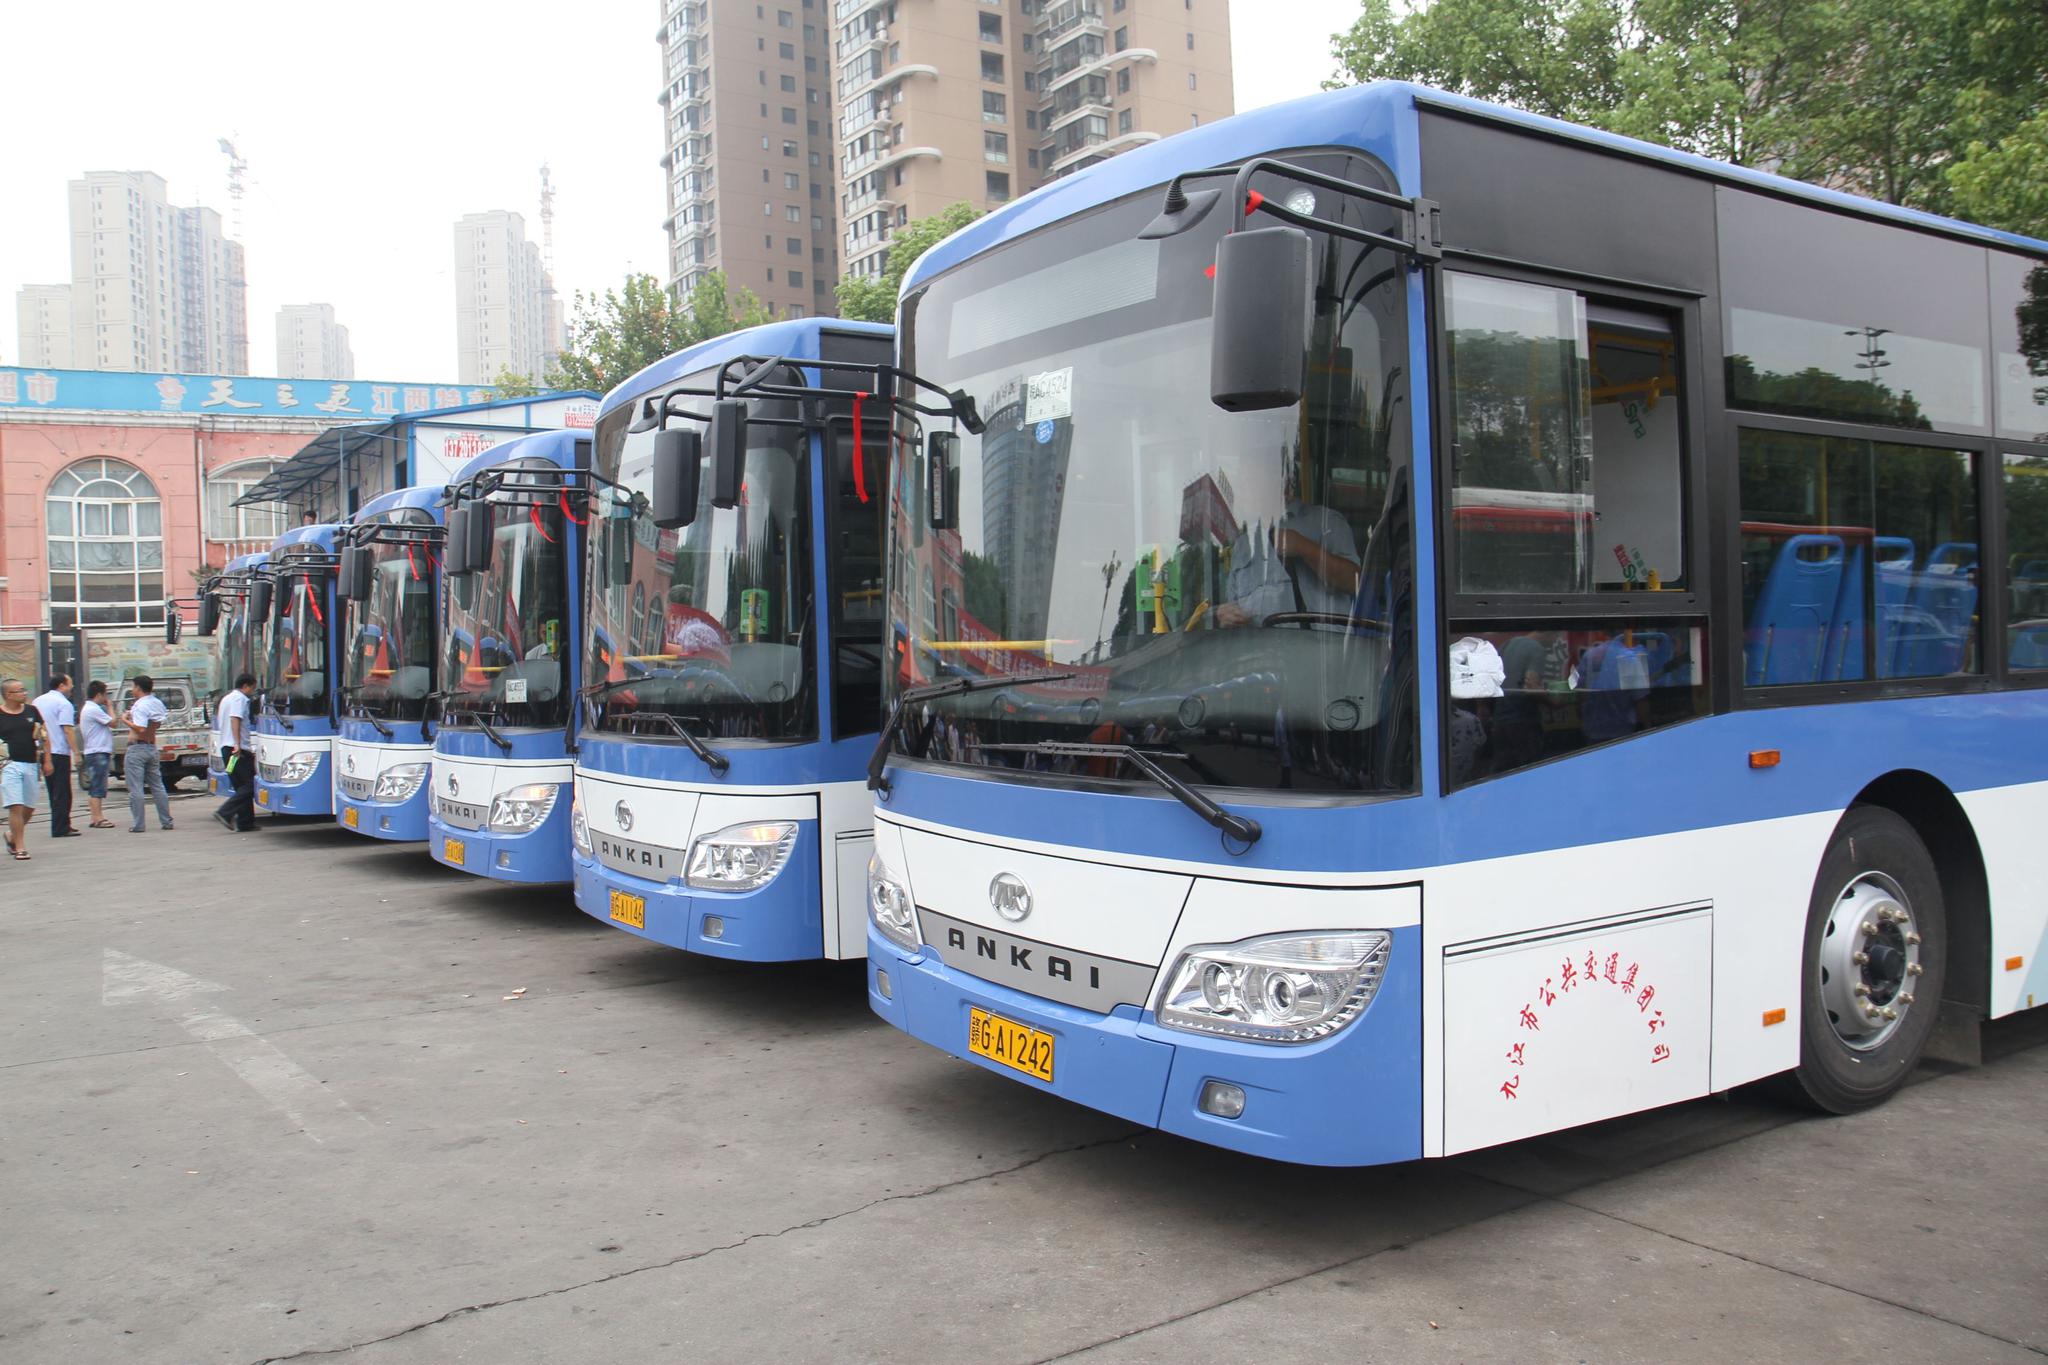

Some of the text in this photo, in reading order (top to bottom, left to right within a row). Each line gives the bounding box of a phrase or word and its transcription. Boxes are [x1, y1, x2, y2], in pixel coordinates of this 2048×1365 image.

[602, 841, 663, 869] ANKAI
[948, 927, 1100, 989] ANKAI
[1499, 950, 1670, 1100] 九江市公共交通集团公司
